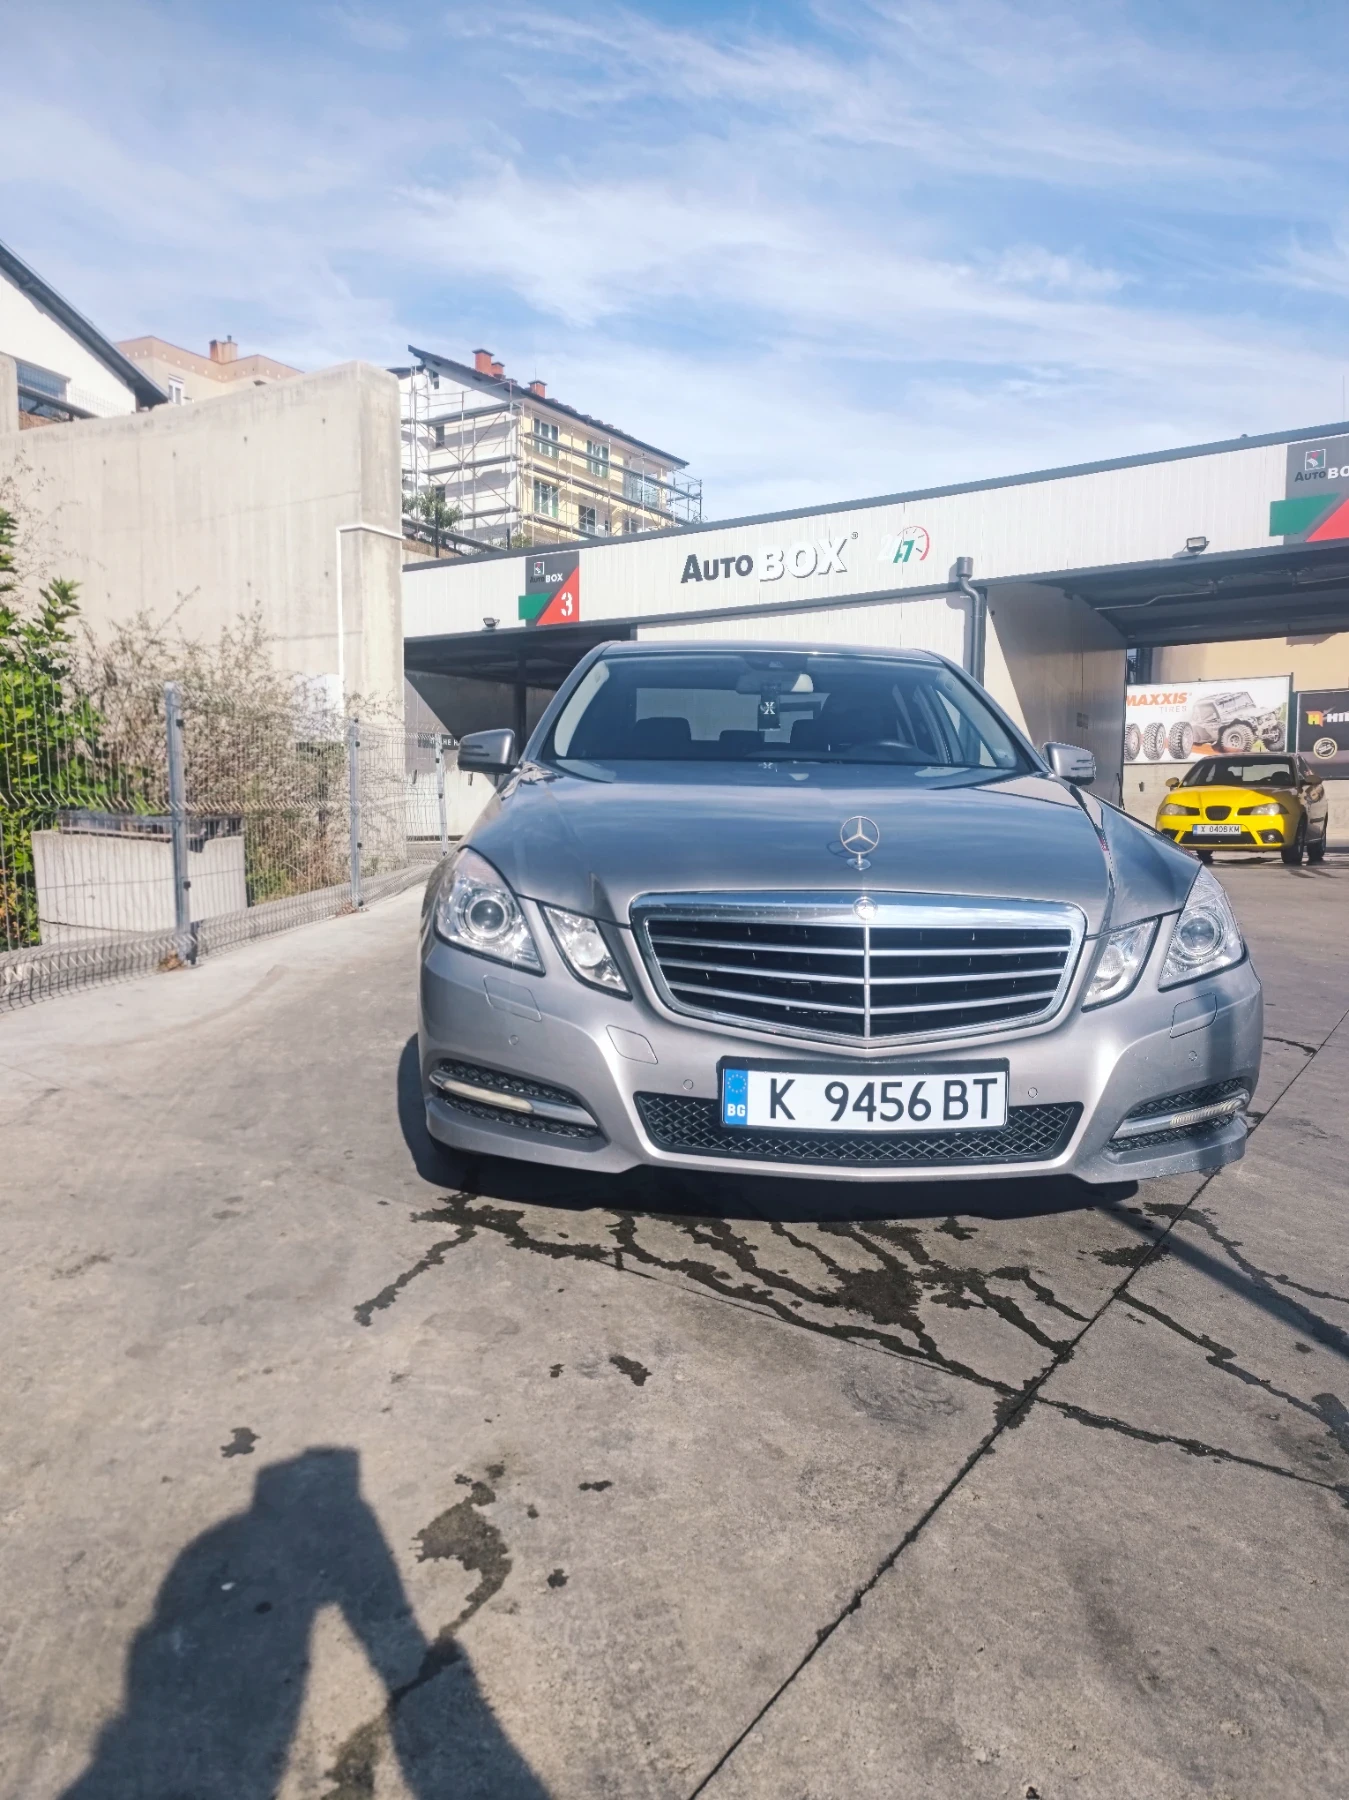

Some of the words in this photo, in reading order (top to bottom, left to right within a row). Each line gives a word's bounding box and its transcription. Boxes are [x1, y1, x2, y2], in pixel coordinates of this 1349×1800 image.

[759, 536, 848, 582] BOX
[545, 573, 563, 583] BOX
[561, 592, 573, 616] 3
[1126, 693, 1188, 706] MAXXIS
[769, 1078, 796, 1121] K
[824, 1081, 932, 1122] 9456
[942, 1078, 998, 1121] BT
[727, 1104, 746, 1117] BG
